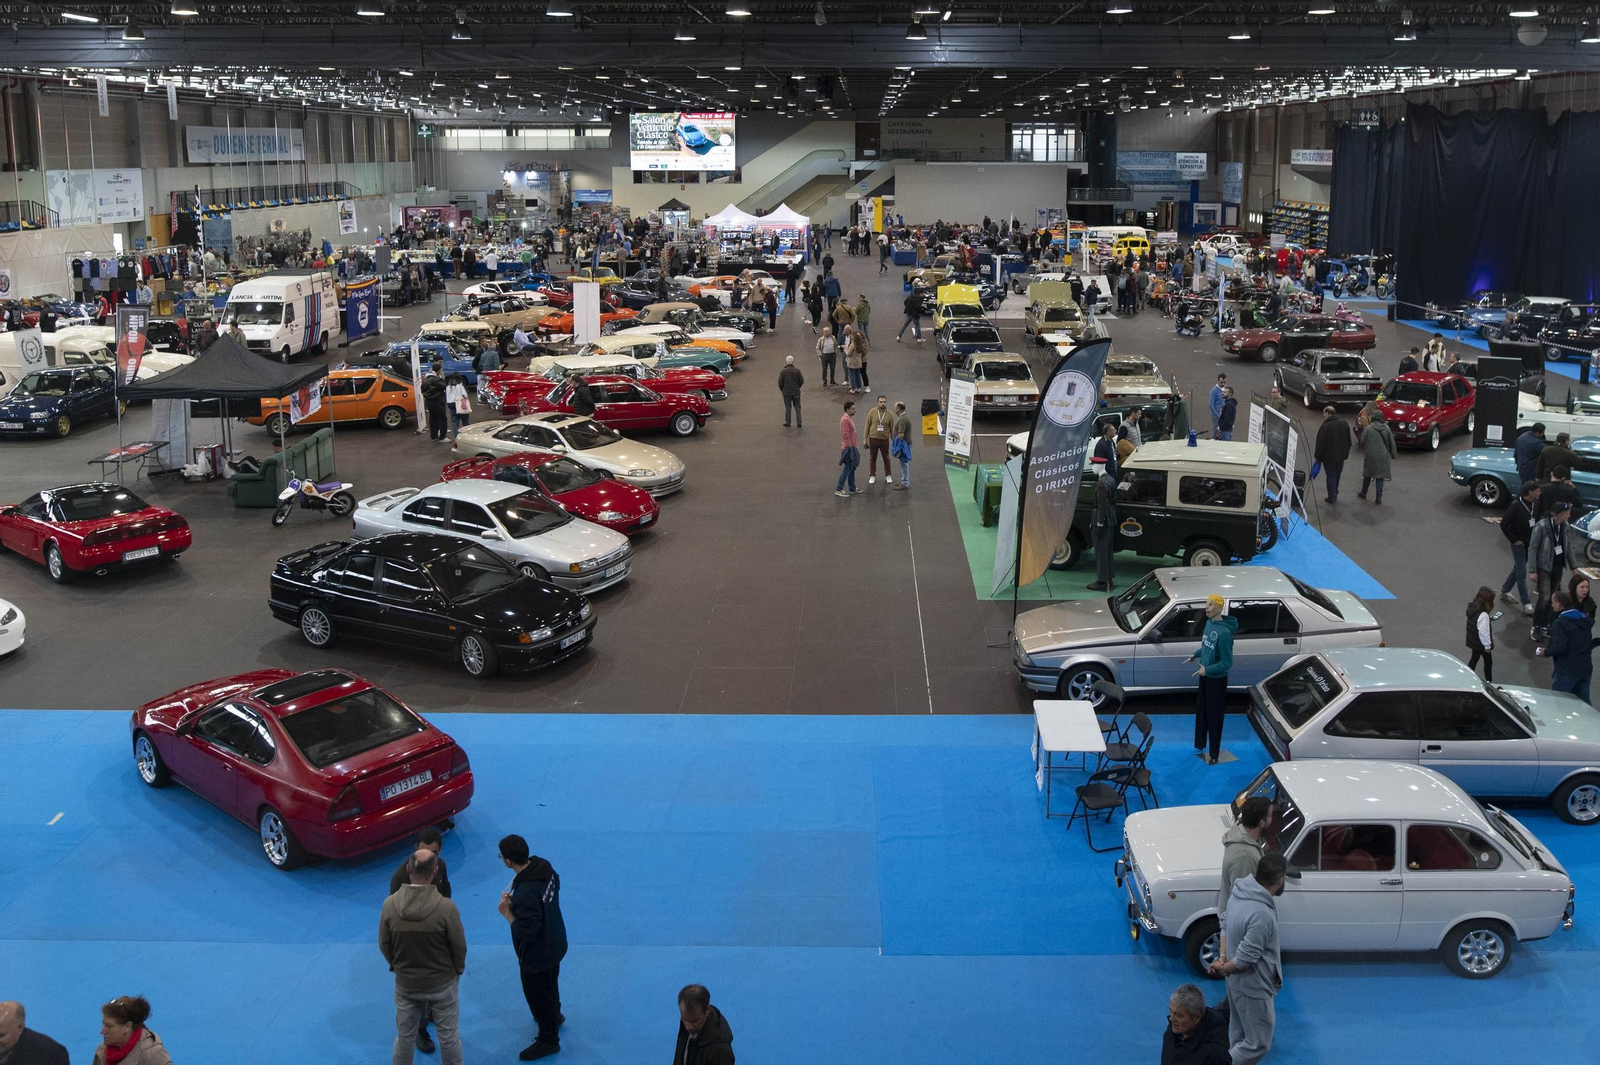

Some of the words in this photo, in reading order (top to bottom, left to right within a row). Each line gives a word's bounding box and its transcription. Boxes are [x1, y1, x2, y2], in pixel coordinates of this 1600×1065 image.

[213, 134, 255, 155] OURENSE
[127, 314, 138, 343] NIPON
[1029, 444, 1087, 466] Asociación
[1034, 461, 1079, 479] Clásicos
[1035, 484, 1042, 494] O
[1045, 475, 1075, 491] IRIXO
[385, 785, 397, 797] PO
[399, 776, 419, 791] 1314
[419, 773, 431, 784] BL
